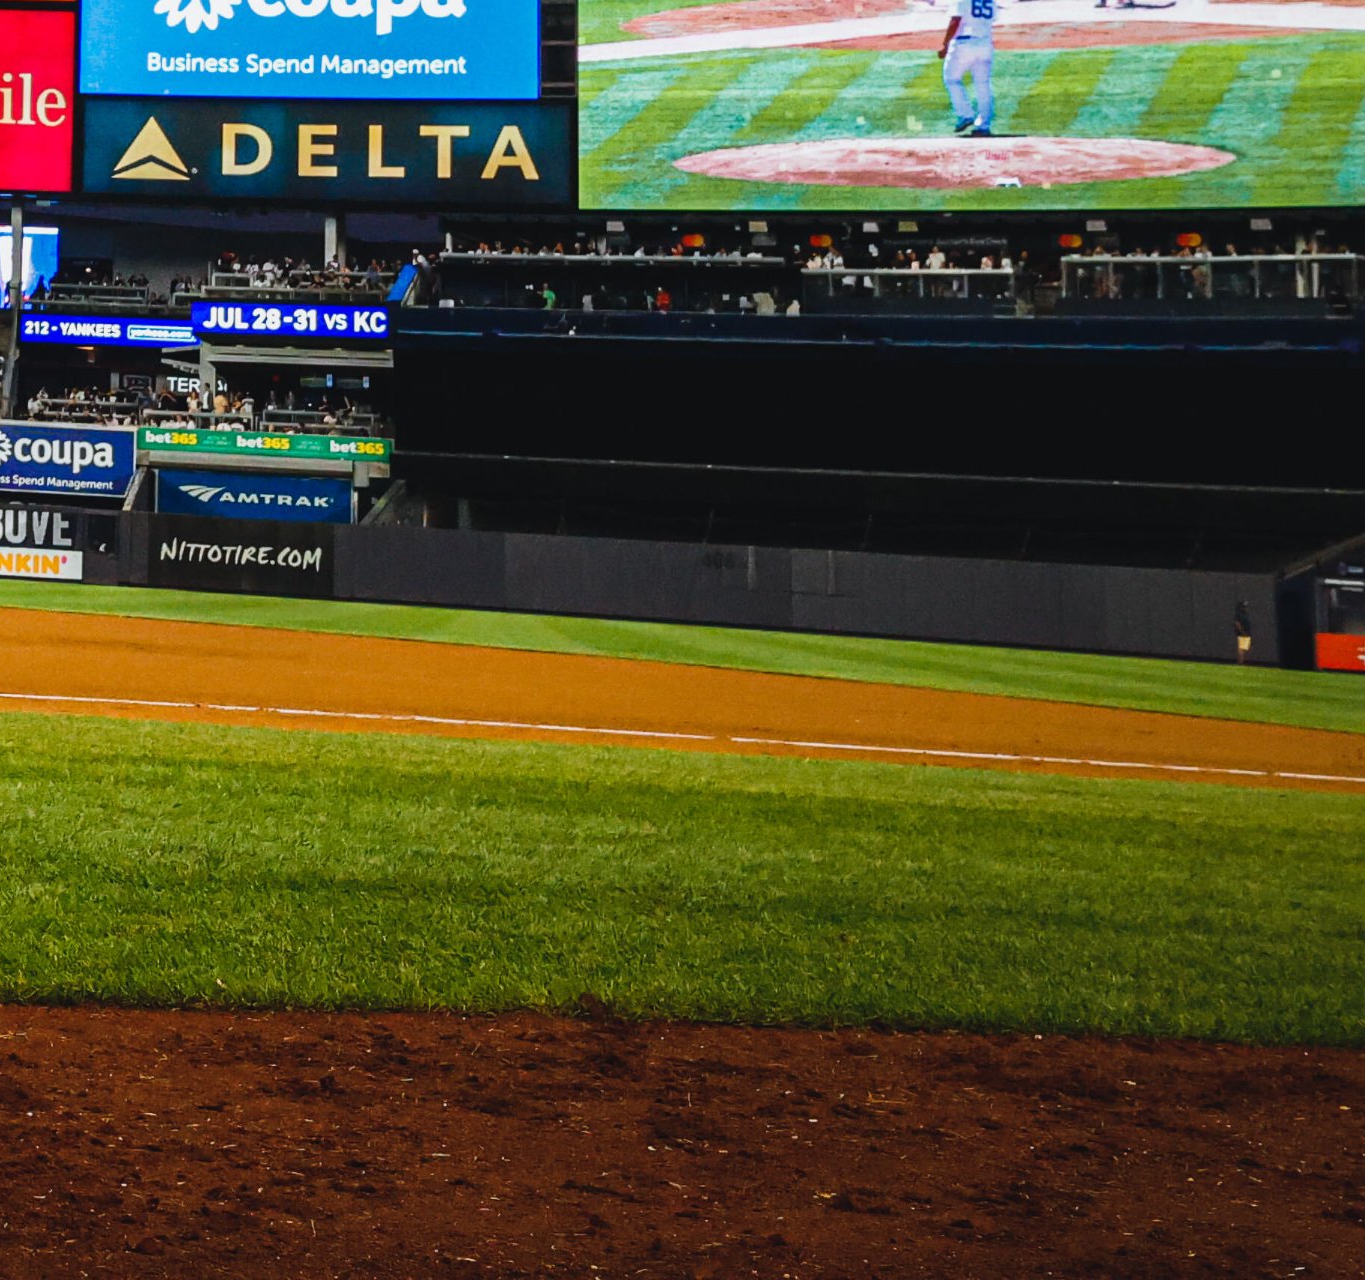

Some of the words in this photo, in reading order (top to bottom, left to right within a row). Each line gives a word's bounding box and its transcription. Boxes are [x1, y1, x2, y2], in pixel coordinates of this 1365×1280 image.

[147, 52, 238, 75] Business
[246, 54, 313, 78] Spend
[320, 54, 467, 79] Management
[221, 123, 540, 180] DELTA
[203, 306, 249, 330] JUL
[354, 311, 387, 333] KC
[14, 437, 114, 474] coupa
[145, 431, 197, 445] bet365
[236, 435, 290, 450] bet365
[329, 440, 384, 454] bet365
[12, 474, 44, 488] Spend
[47, 477, 113, 491] Management
[219, 492, 330, 507] AMTRAK
[160, 537, 322, 572] NITTOTIRE.COM
